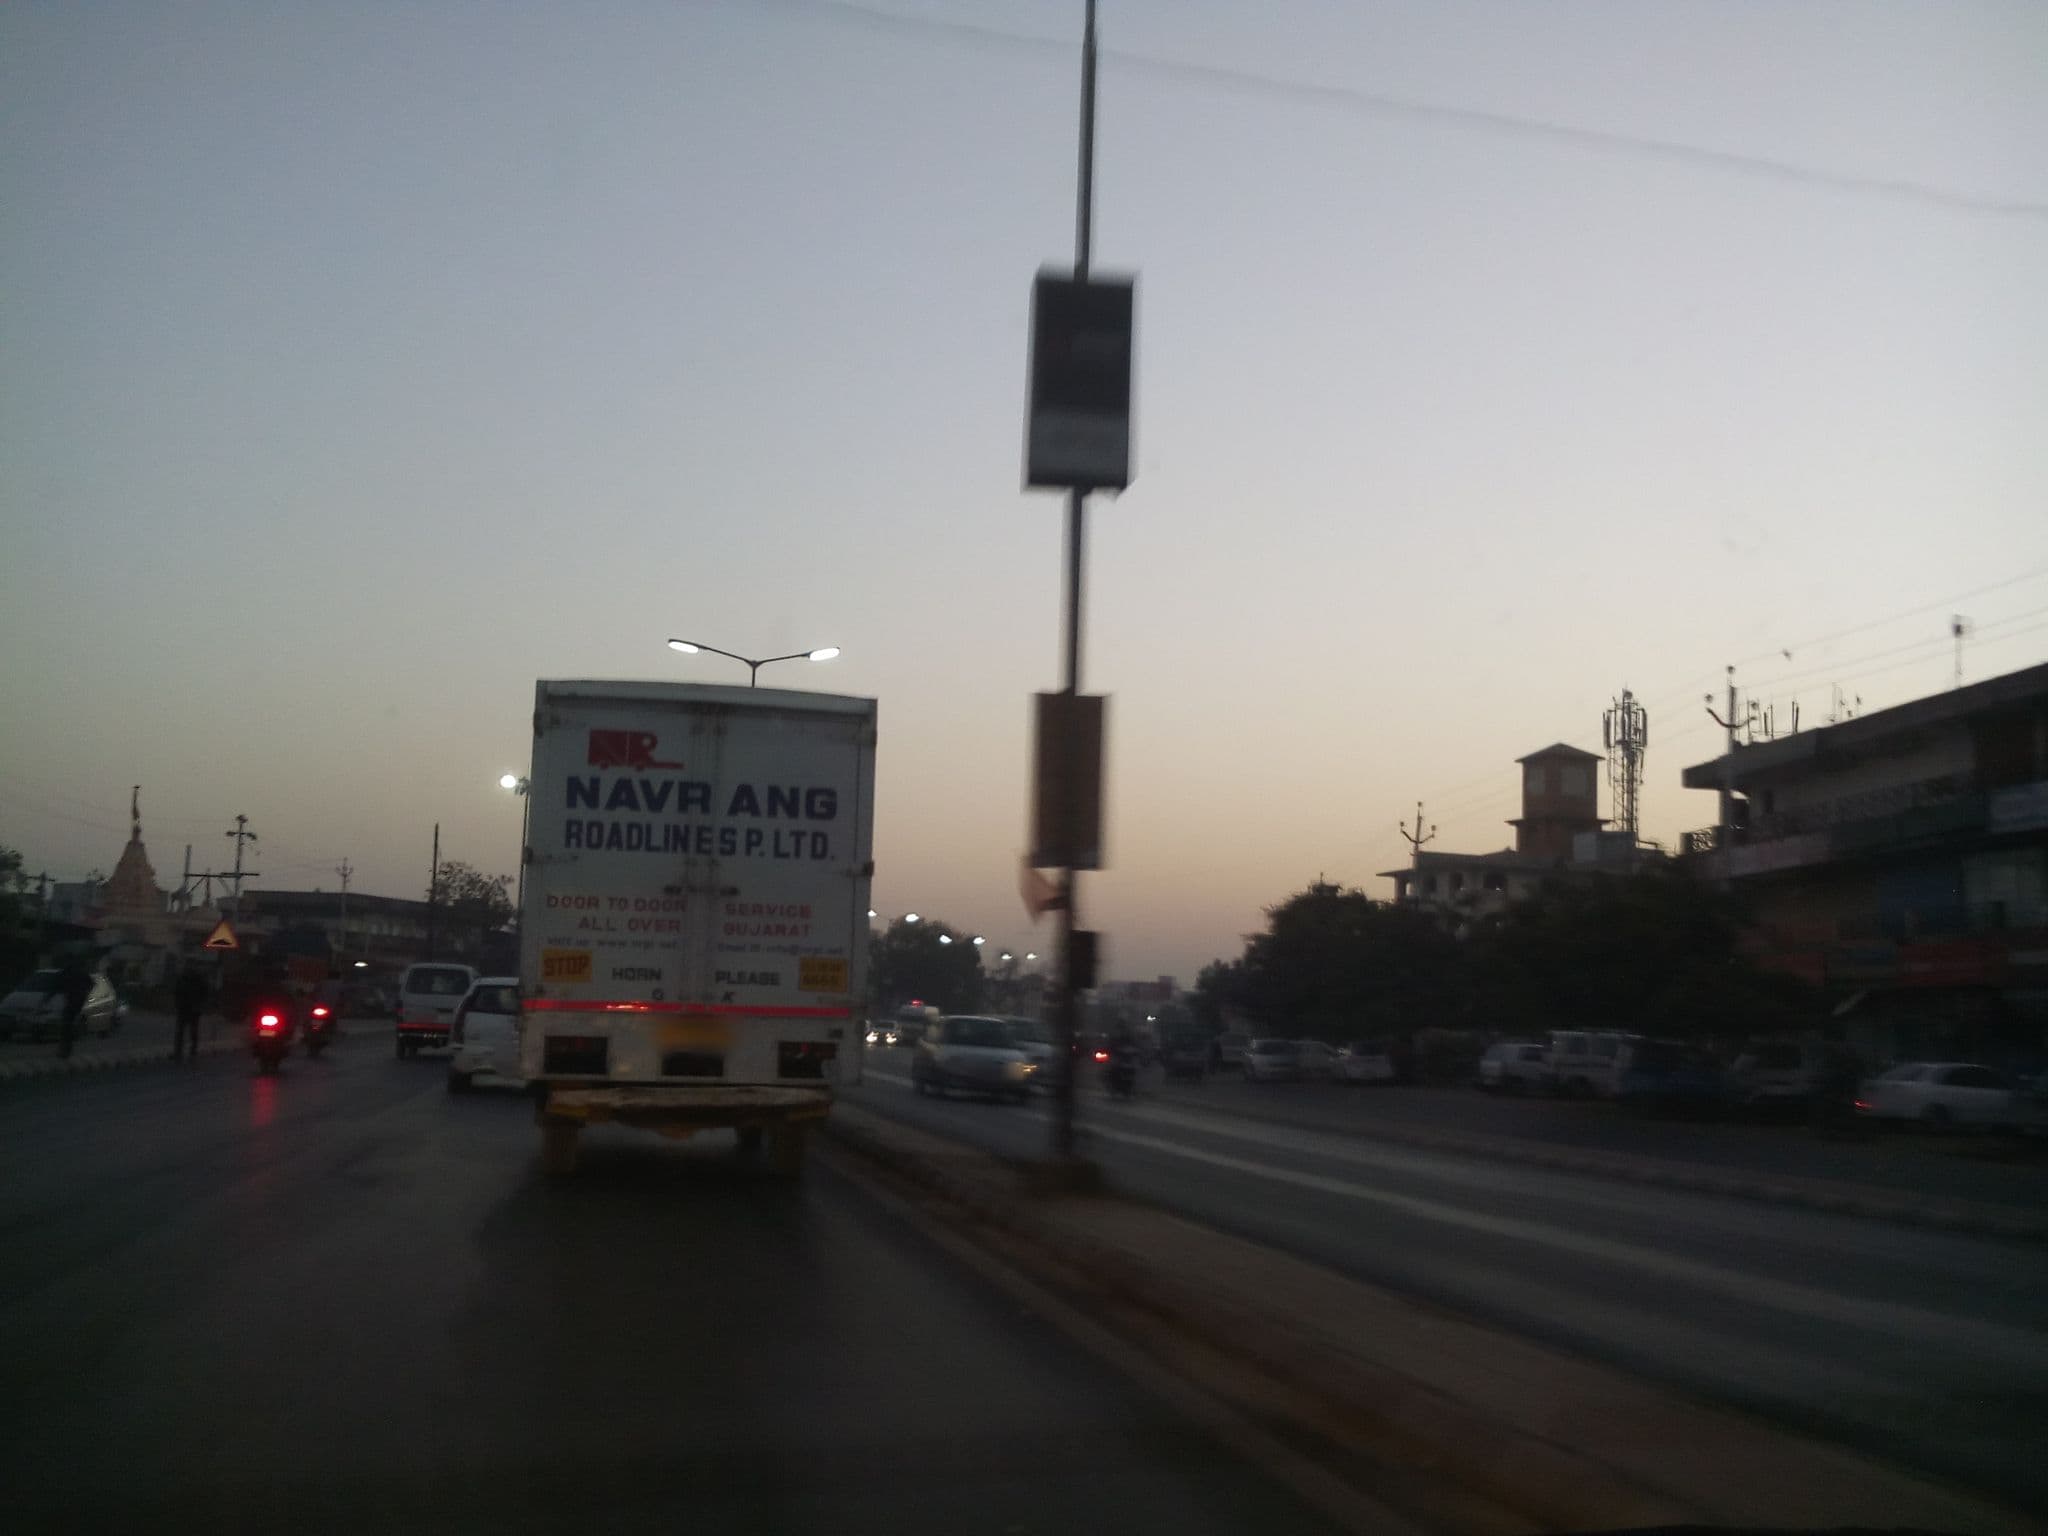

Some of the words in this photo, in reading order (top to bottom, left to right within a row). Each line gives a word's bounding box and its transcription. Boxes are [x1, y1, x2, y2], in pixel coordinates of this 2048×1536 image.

[546, 895, 599, 910] DOOR
[607, 897, 629, 912] TO
[634, 897, 688, 913] DOOR
[725, 903, 812, 919] SERVICE
[579, 916, 617, 931] ALL
[628, 918, 681, 932] OVER
[723, 922, 811, 937] GUJARAT
[612, 967, 662, 981] HORN
[715, 970, 781, 986] PLEASE
